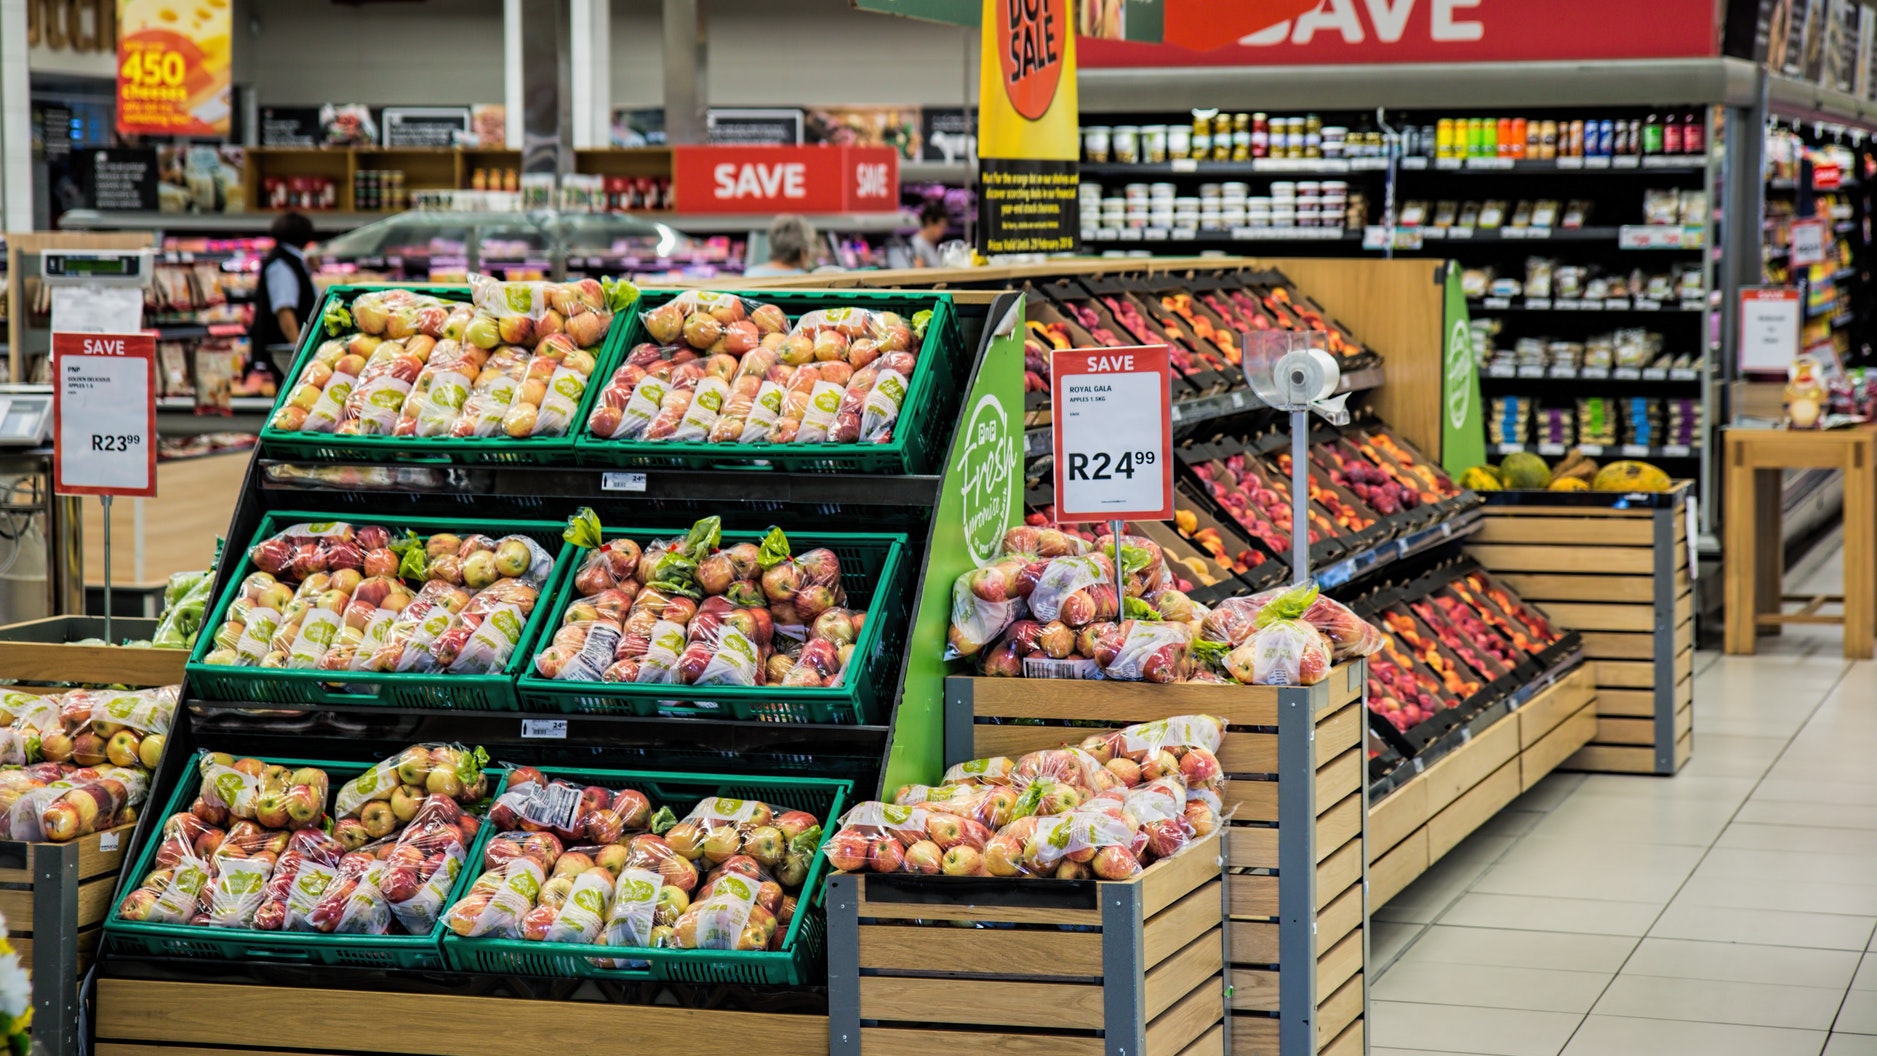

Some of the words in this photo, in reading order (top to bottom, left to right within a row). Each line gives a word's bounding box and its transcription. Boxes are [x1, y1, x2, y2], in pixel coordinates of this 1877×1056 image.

[1009, 14, 1057, 84] SALE
[121, 51, 185, 86] 450
[714, 163, 806, 198] SAVE
[856, 163, 888, 198] SAVE
[83, 339, 125, 355] SAVE
[1087, 355, 1134, 372] SAVE
[1093, 385, 1113, 393] GALA
[957, 412, 1018, 508] Fresh
